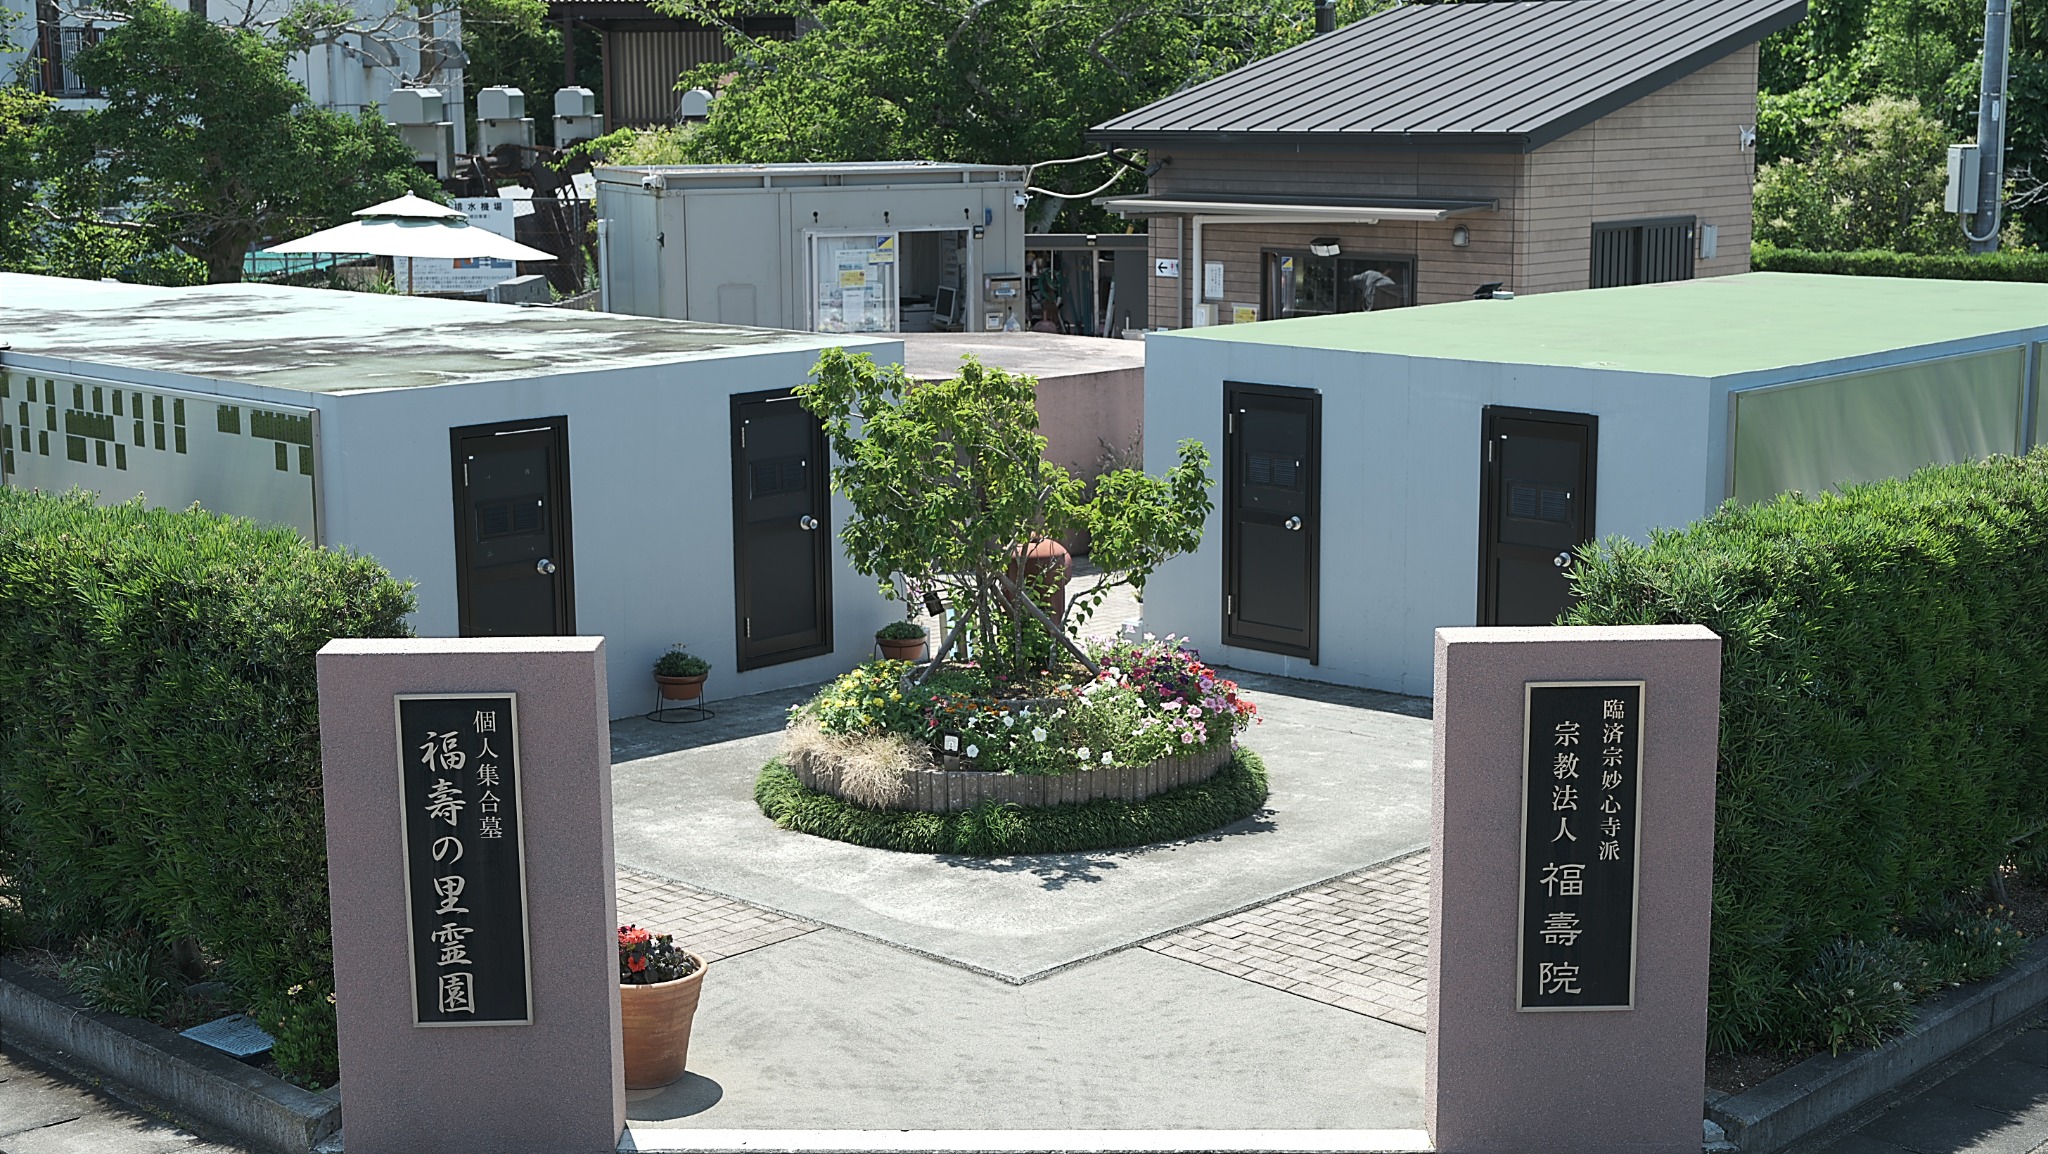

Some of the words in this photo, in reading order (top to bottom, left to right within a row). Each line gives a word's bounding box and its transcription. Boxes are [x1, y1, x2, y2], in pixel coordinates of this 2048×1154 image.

[473, 710, 503, 839] 個人集合墓
[1551, 720, 1581, 843] 宗教法人
[1598, 699, 1625, 861] 臨済宗妙心寺派
[418, 731, 476, 1015] 福壽の里霊園
